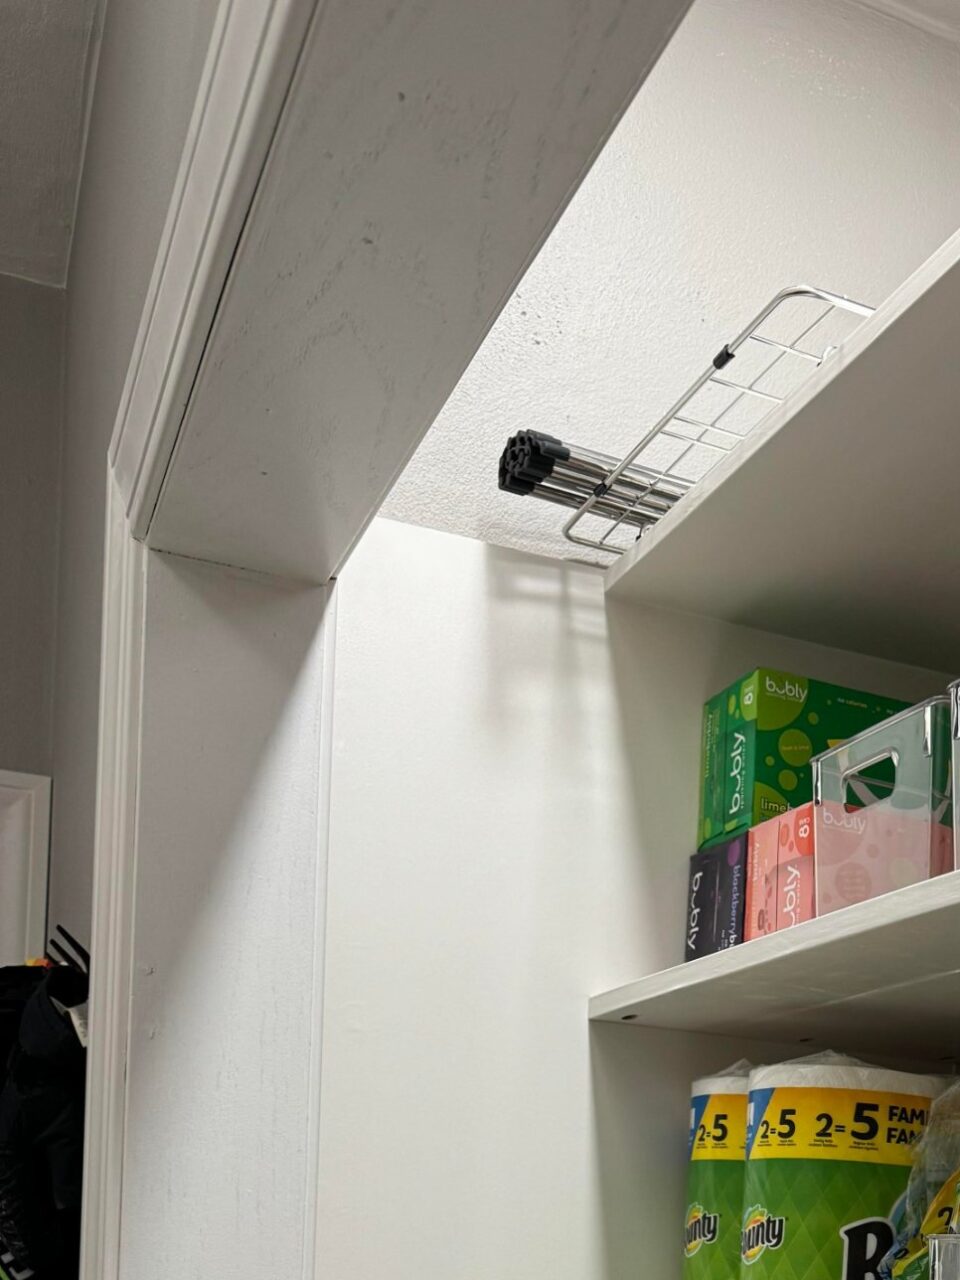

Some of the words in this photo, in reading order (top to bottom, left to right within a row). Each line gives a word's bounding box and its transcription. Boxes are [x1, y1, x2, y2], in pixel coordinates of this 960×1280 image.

[766, 676, 807, 703] bubly
[729, 732, 746, 814] bubly
[799, 825, 810, 837] 8
[688, 871, 703, 950] bubly
